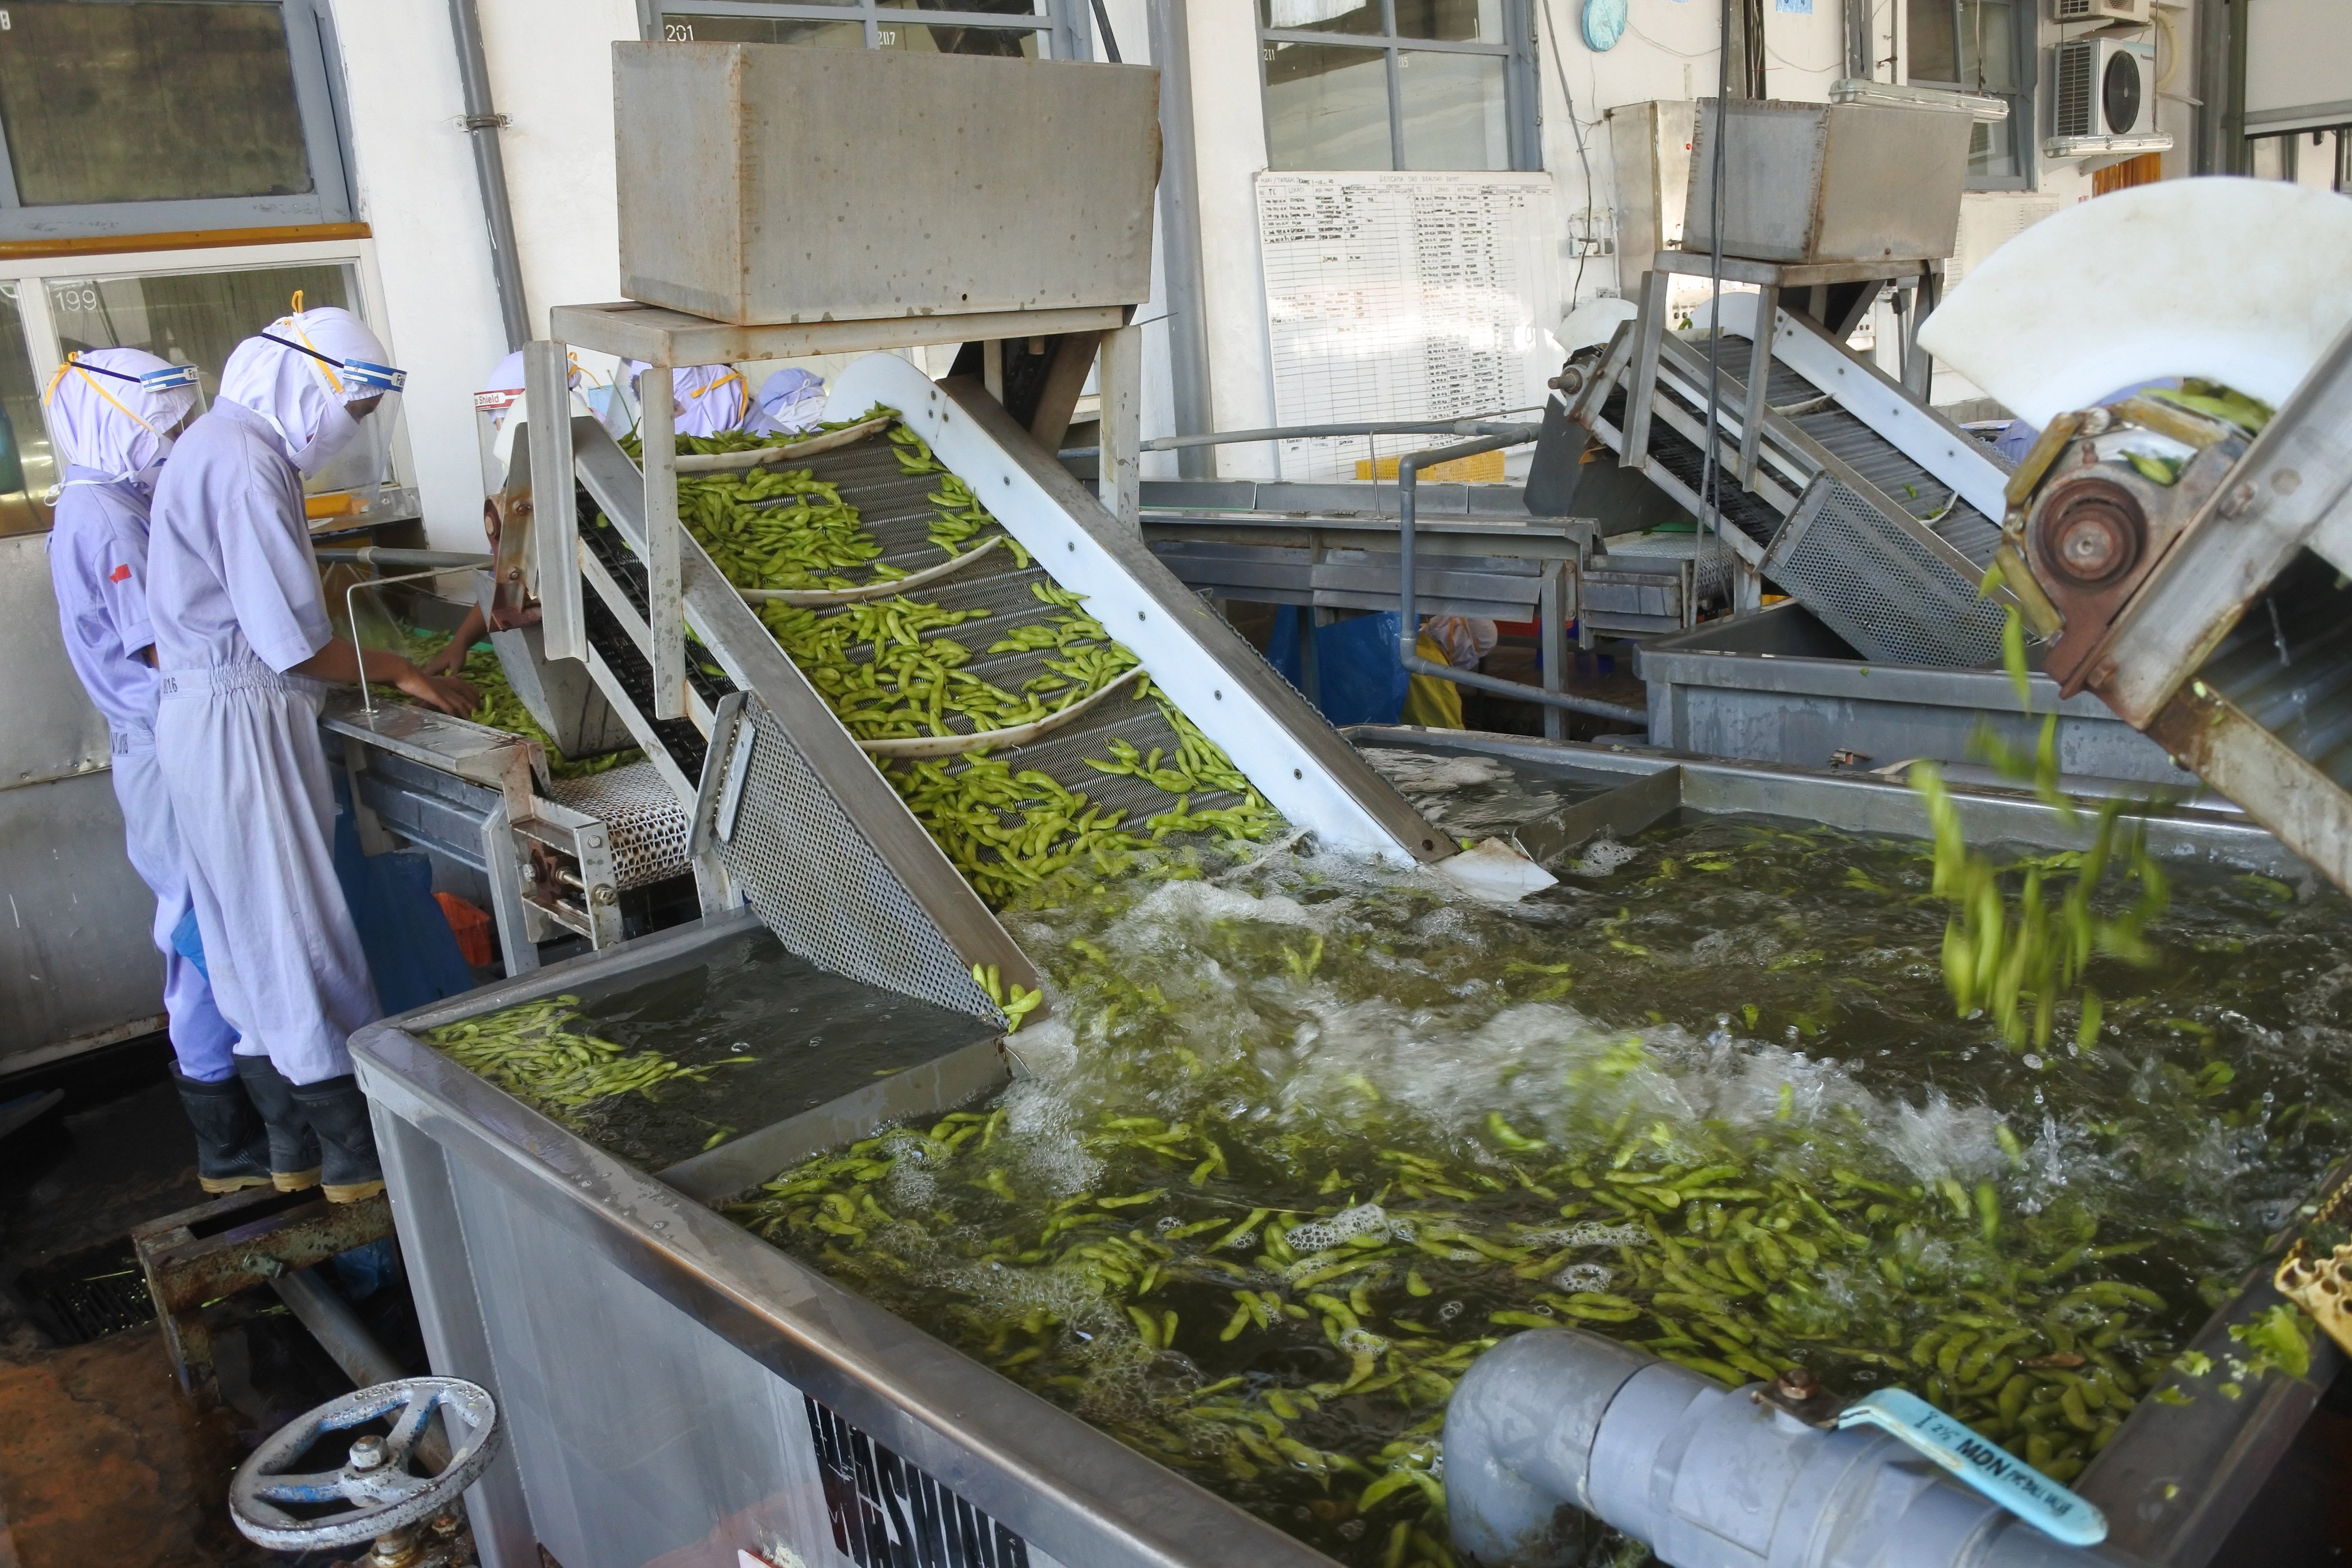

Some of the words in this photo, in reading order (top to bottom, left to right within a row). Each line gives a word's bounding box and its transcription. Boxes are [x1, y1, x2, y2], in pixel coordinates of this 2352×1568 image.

[666, 25, 694, 42] 201
[1264, 49, 1275, 61] 211
[1398, 56, 1409, 68] 215
[55, 289, 97, 312] 199
[479, 394, 500, 404] Shield
[1955, 1438, 2012, 1476] MDN
